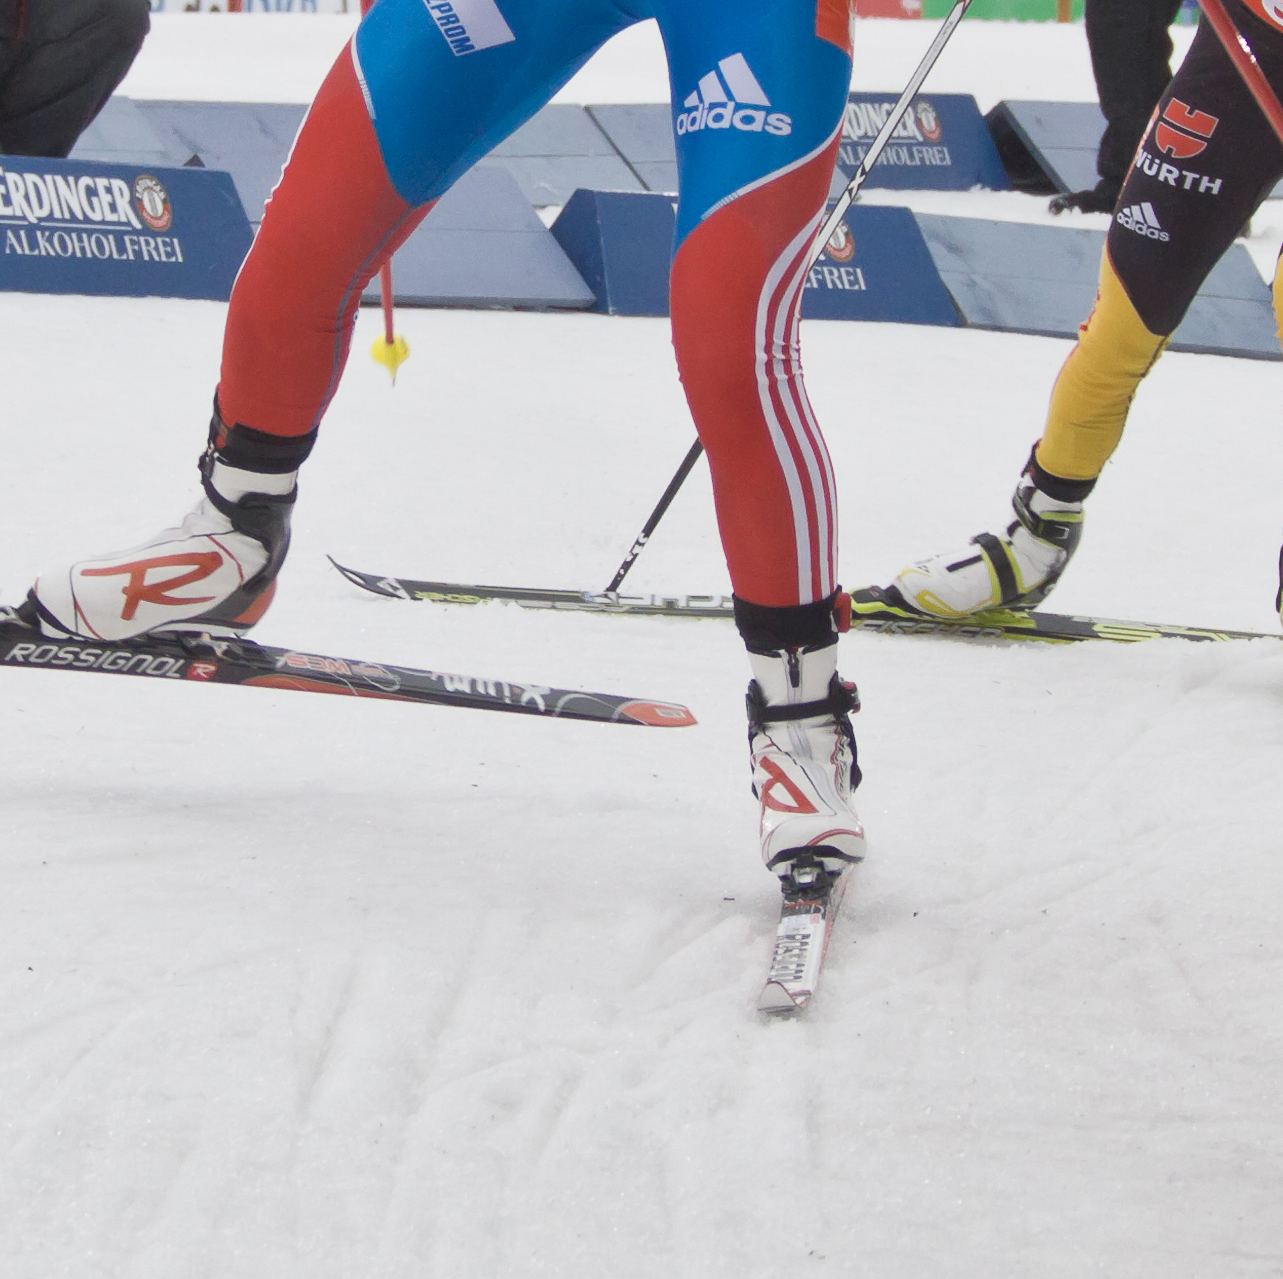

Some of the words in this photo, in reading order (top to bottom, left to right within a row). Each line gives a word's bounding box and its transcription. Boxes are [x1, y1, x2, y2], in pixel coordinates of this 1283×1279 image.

[676, 101, 792, 136] adidas
[1117, 212, 1170, 242] adidas
[5, 229, 184, 263] ALKOHOLFREI
[4, 642, 185, 678] ROSSIGNOL
